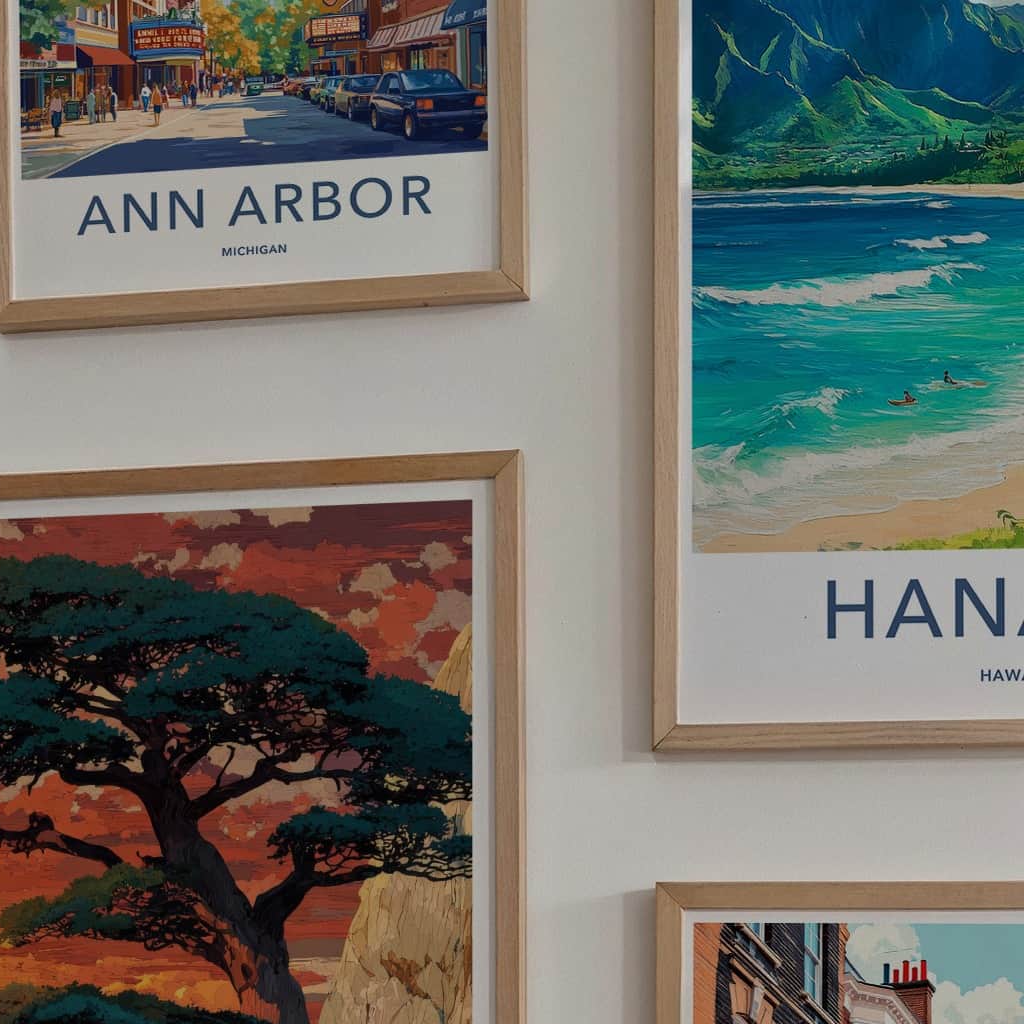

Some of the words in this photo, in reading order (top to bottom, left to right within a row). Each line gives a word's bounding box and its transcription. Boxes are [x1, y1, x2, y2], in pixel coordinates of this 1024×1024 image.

[77, 189, 205, 236] ANN
[228, 175, 432, 227] ARBOR
[221, 243, 288, 257] MICHIGAN
[826, 577, 1024, 639] HAN
[980, 669, 1024, 682] HAW
